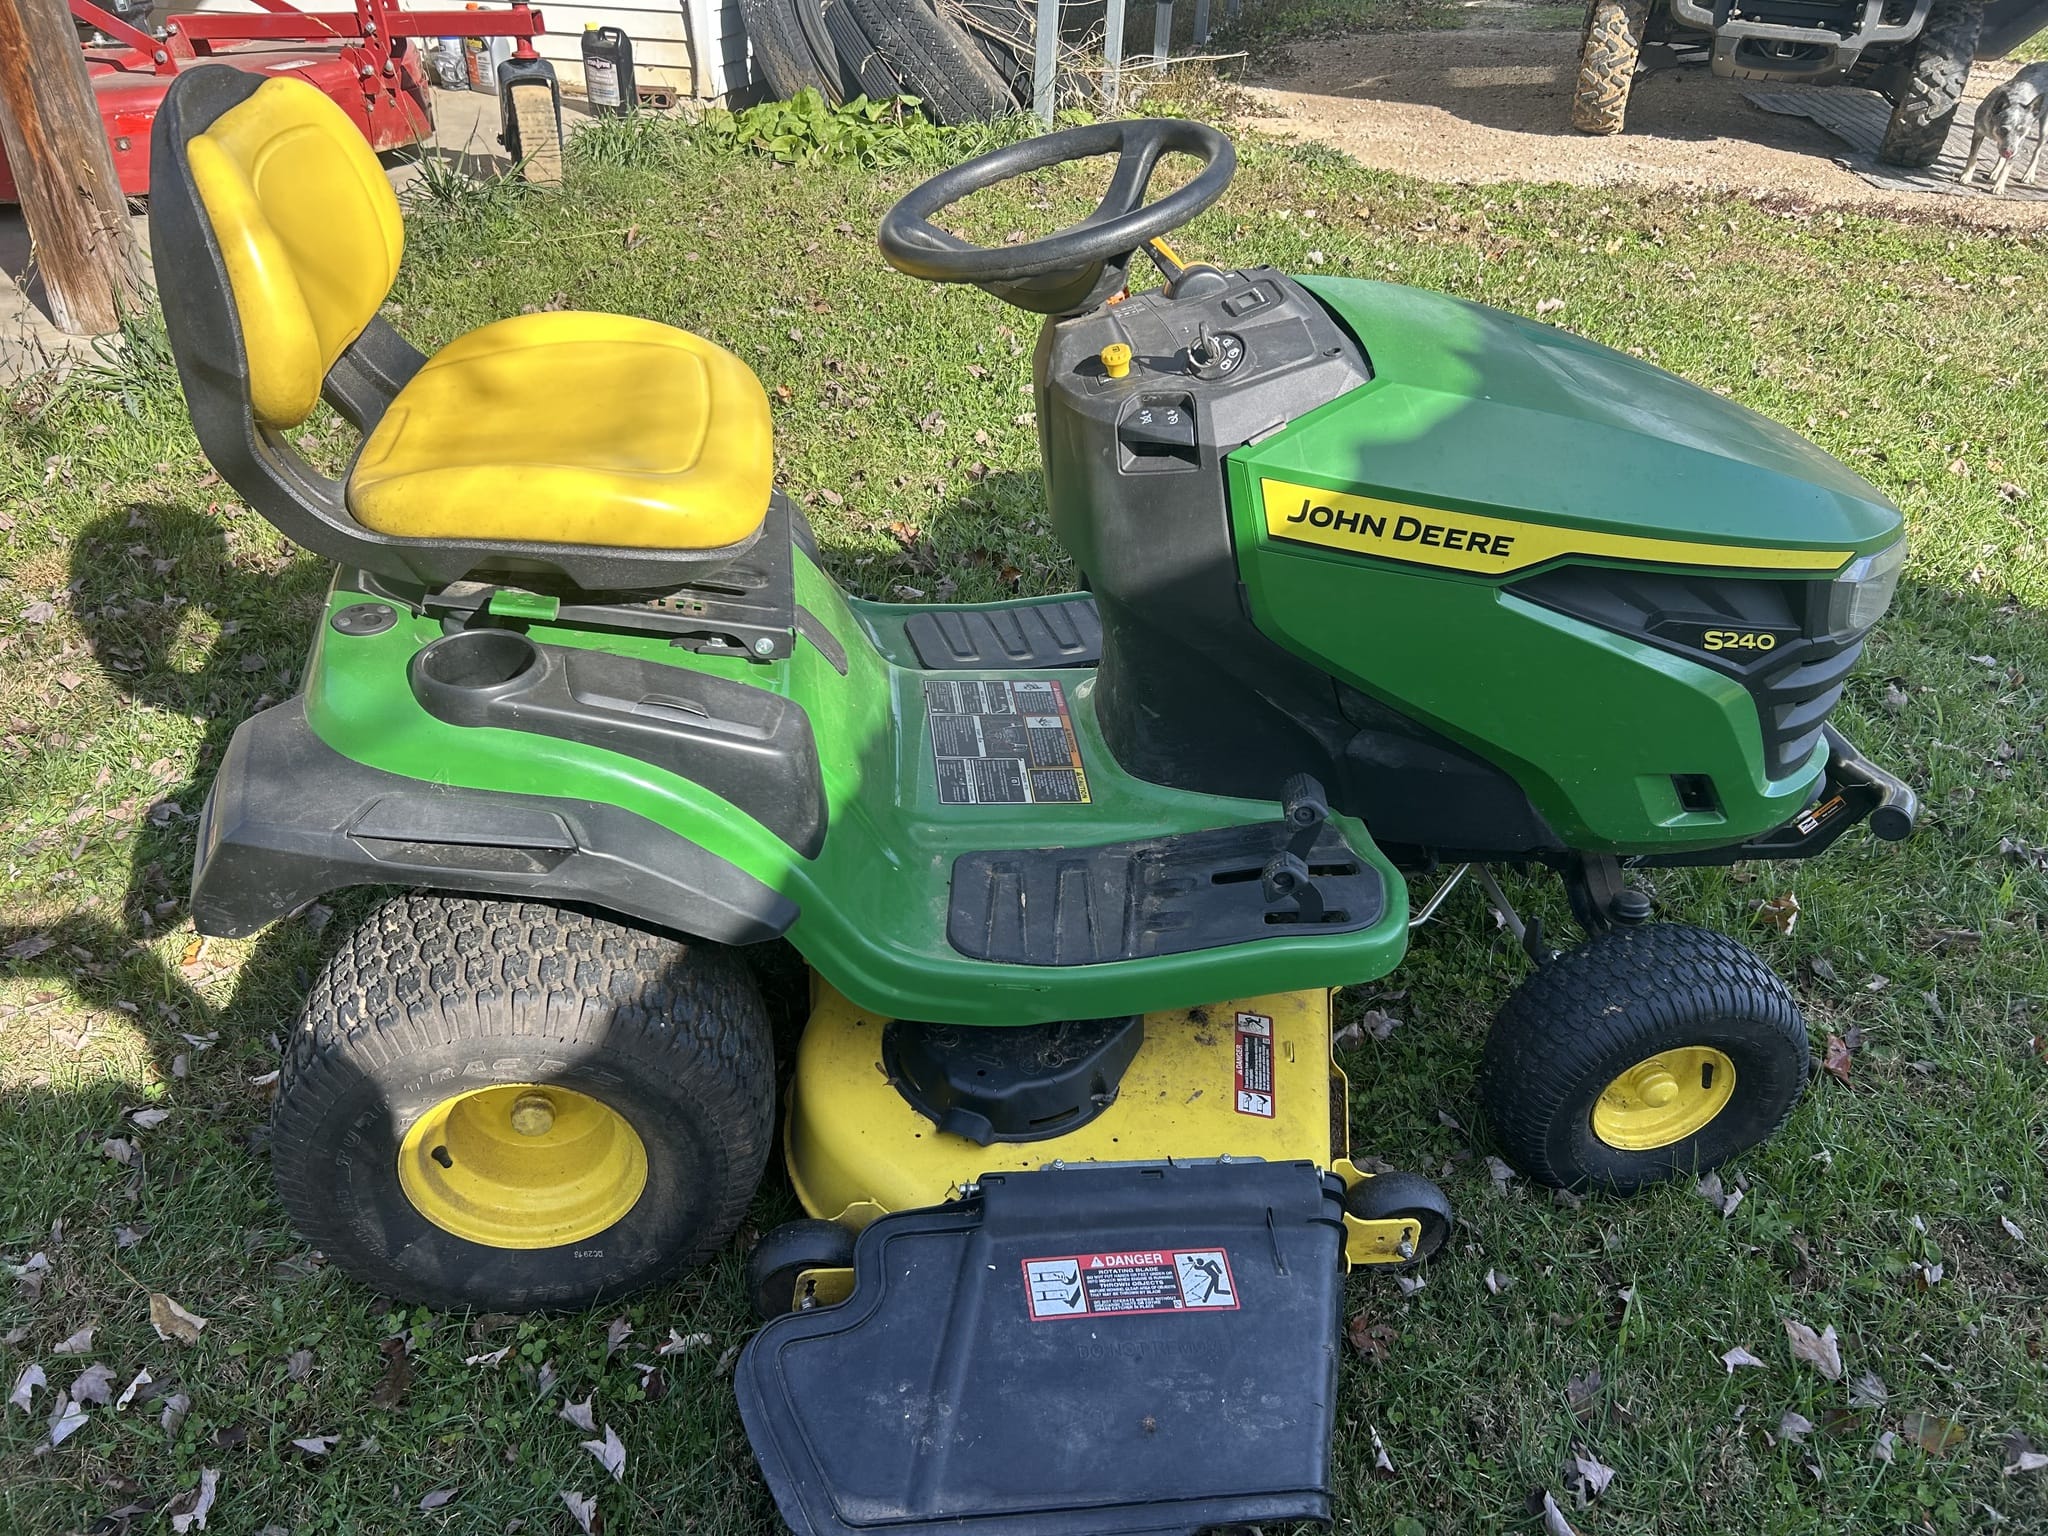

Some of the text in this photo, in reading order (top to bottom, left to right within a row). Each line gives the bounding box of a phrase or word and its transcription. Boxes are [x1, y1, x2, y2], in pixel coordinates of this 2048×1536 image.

[1287, 499, 1515, 557] JOHN DEERE
[1703, 630, 1775, 651] S240
[1077, 776, 1089, 799] CAUTION
[1105, 1253, 1163, 1266] DANGER
